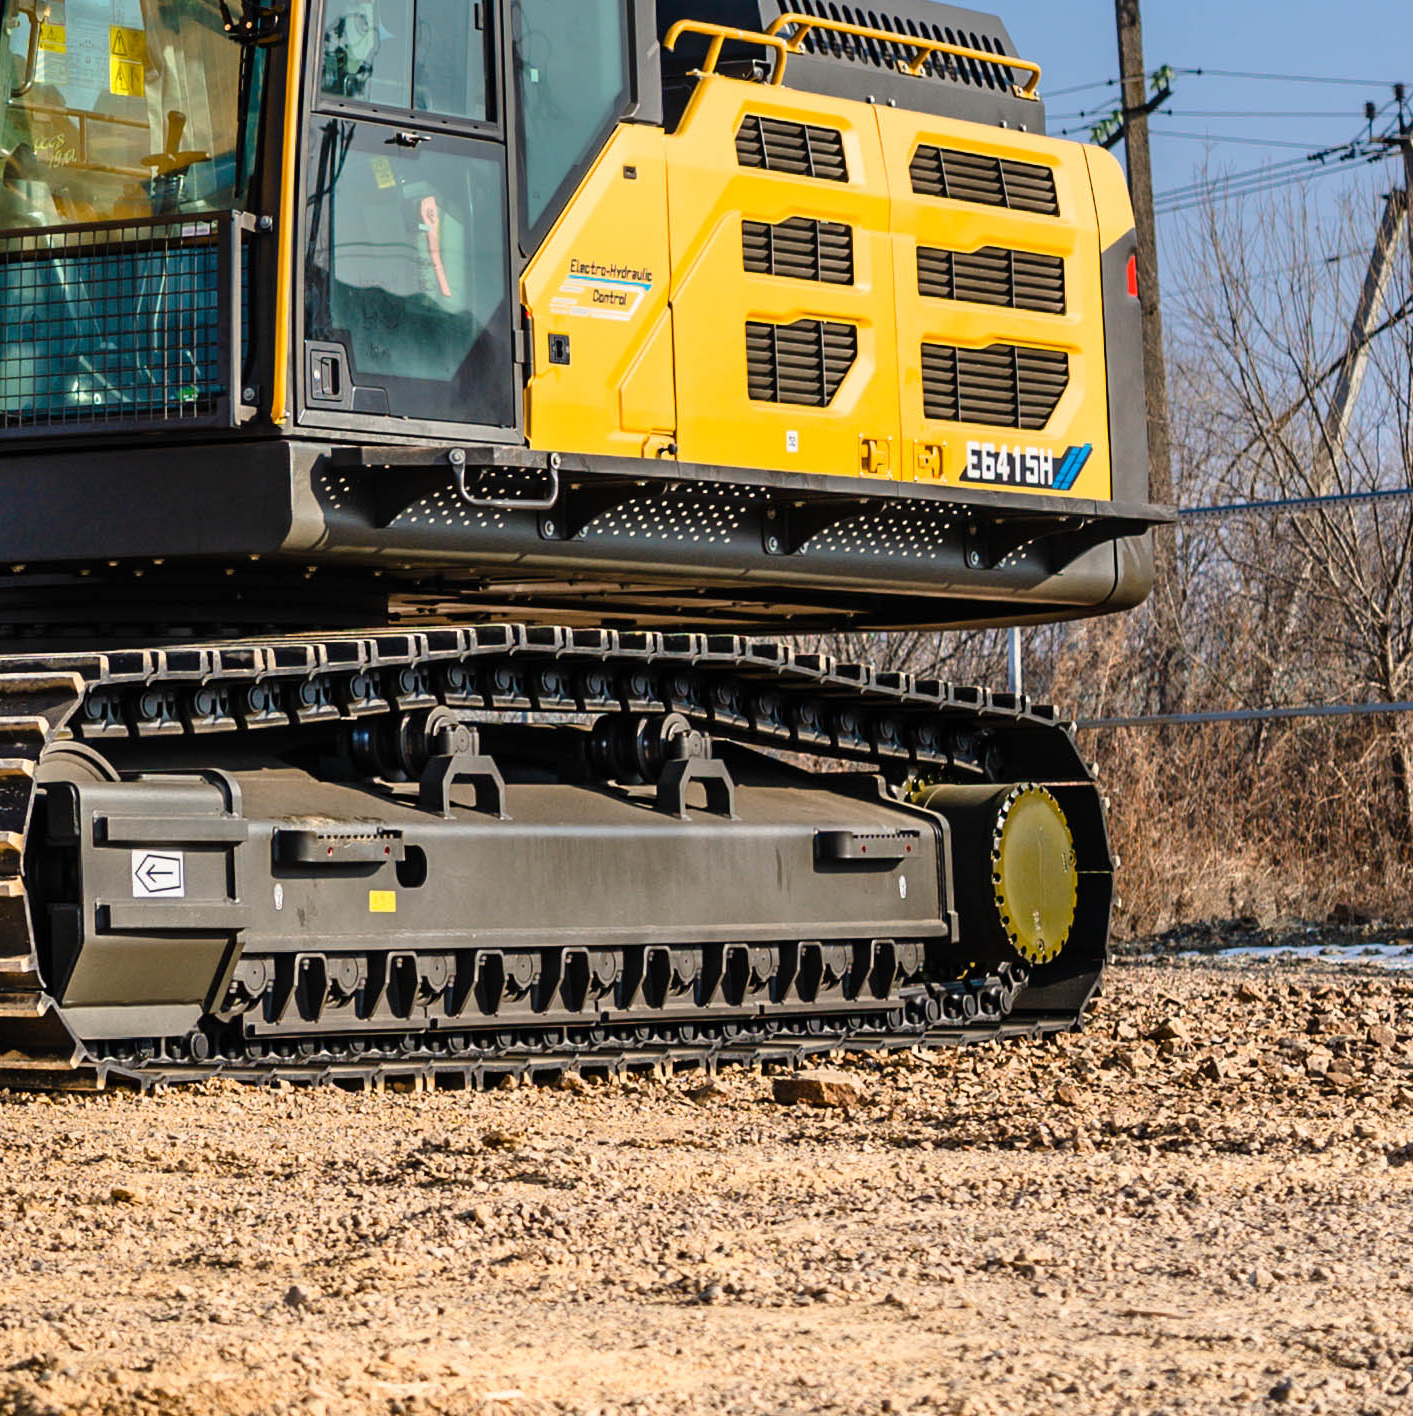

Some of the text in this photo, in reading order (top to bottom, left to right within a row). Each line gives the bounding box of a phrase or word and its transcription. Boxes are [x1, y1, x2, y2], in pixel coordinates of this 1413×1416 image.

[570, 259, 652, 281] Electro-Hydraulic
[592, 289, 627, 305] Control
[966, 440, 1053, 485] E6415H
